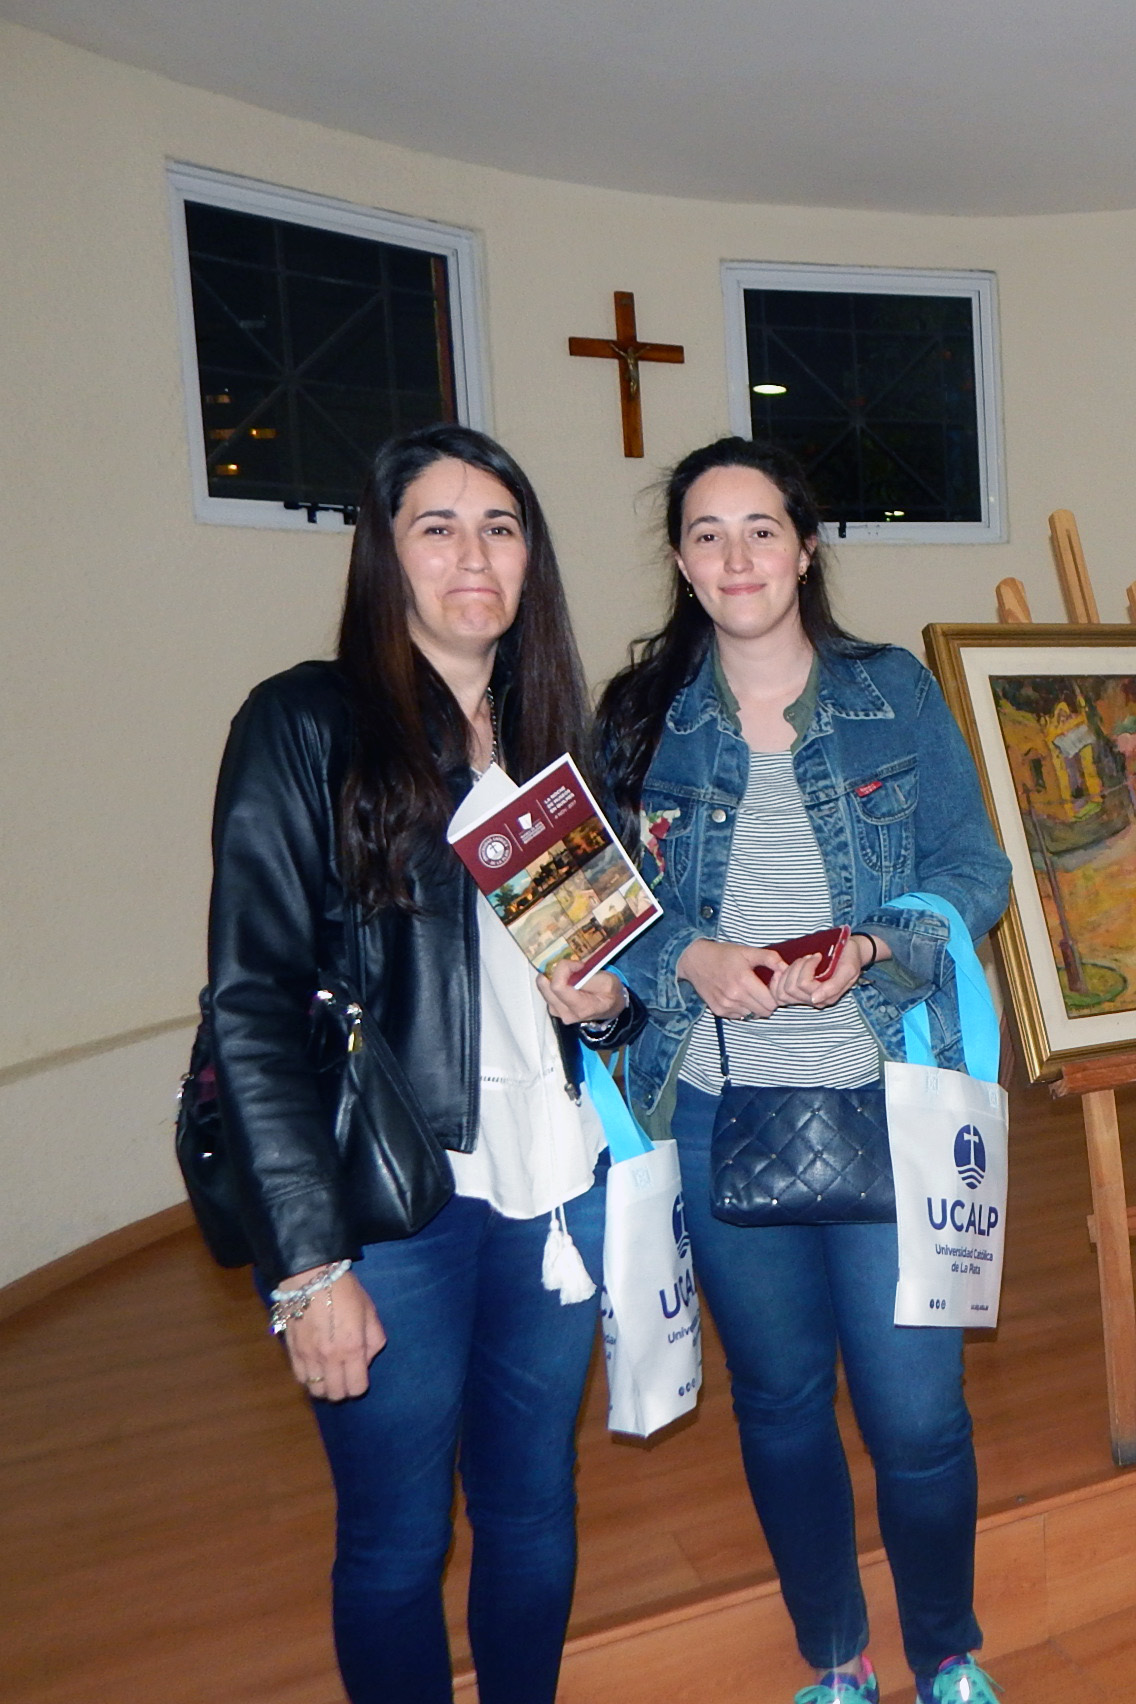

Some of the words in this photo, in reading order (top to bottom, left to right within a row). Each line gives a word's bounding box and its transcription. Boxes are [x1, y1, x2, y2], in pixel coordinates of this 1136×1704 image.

[927, 1197, 999, 1237] UCALP
[935, 1244, 973, 1259] Universidad
[974, 1248, 994, 1261] Católica
[951, 1261, 960, 1273] de
[960, 1262, 968, 1274] La
[969, 1263, 981, 1275] Plata
